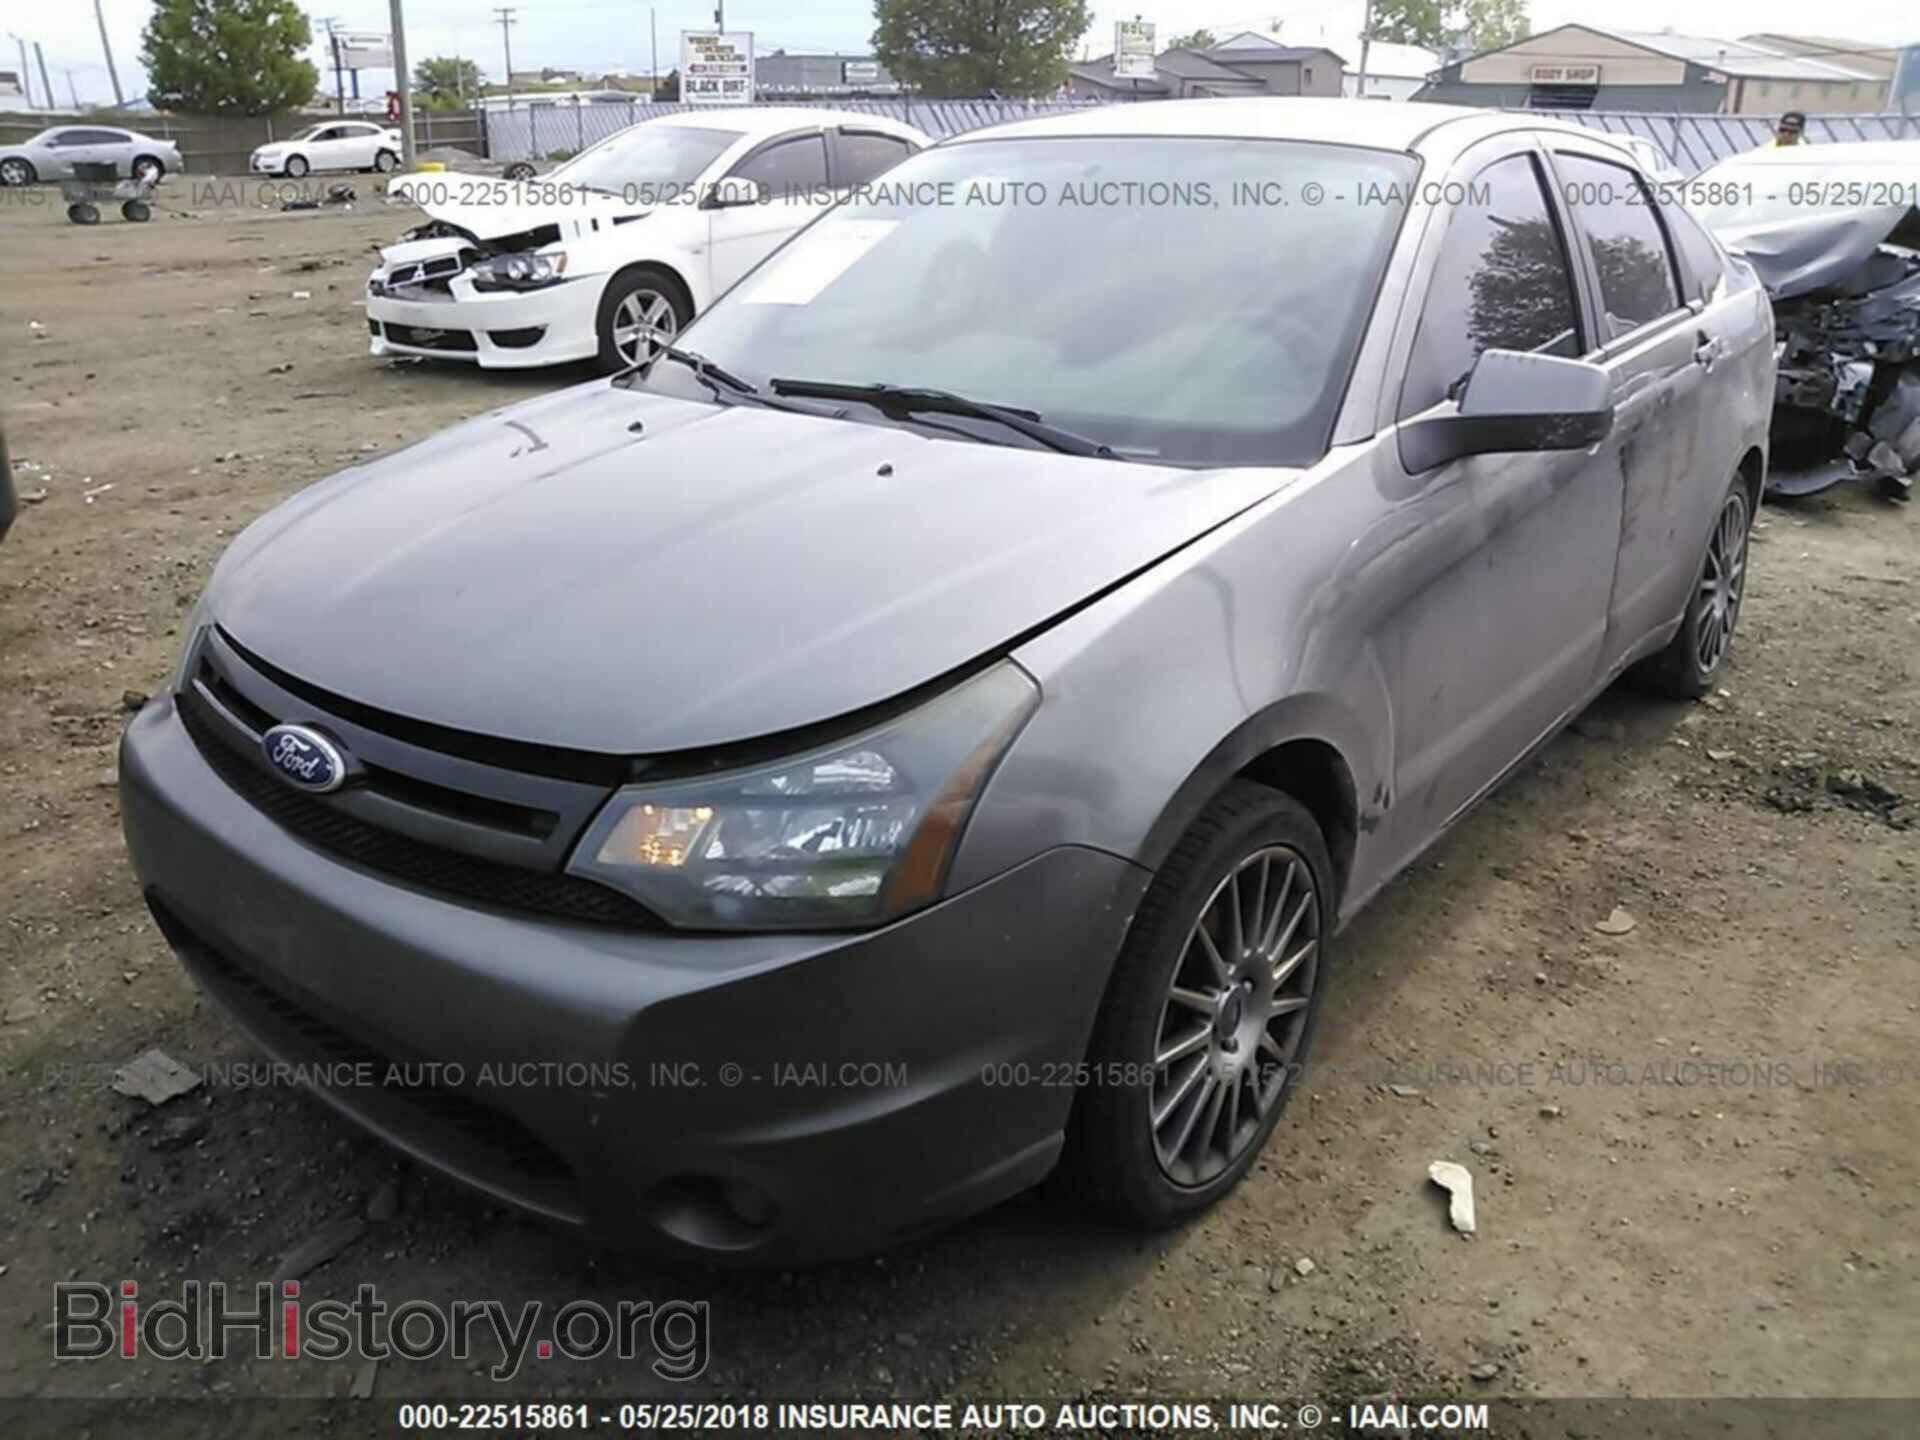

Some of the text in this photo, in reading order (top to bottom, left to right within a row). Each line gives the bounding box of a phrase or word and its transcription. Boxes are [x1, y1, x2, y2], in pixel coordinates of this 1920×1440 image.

[1535, 68, 1595, 80] BODY SHOP
[686, 80, 719, 93] BLACK
[272, 733, 320, 779] Ford
